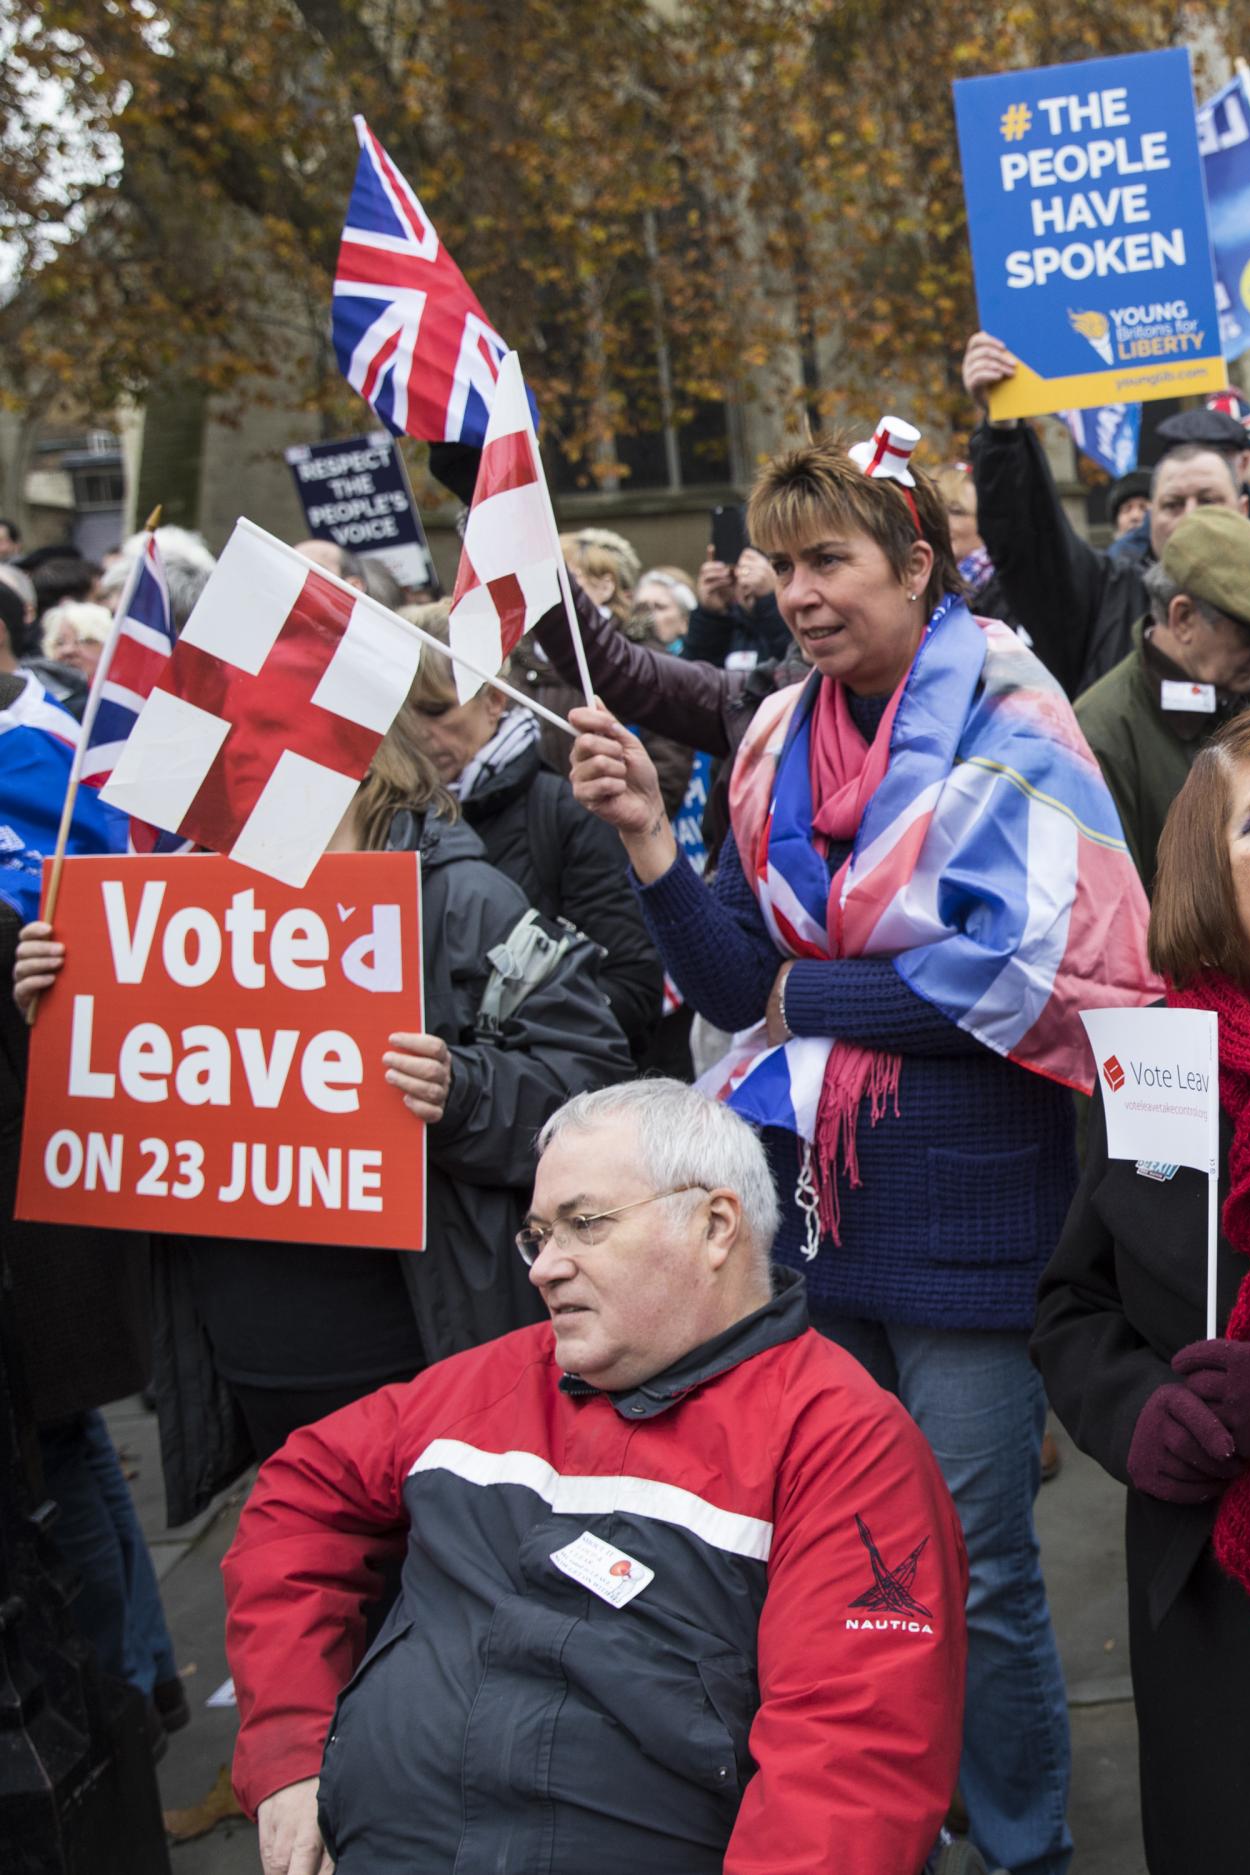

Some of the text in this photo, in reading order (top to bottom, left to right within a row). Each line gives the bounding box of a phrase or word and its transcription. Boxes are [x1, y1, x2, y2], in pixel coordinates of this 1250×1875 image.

[1037, 87, 1131, 135] THE
[1000, 131, 1170, 192] PEOPLE
[1031, 183, 1151, 236] HAVE
[1005, 228, 1186, 289] SPOKEN
[1109, 300, 1188, 326] YOUNG
[1116, 320, 1197, 342] Britons for
[1118, 332, 1204, 360] LIBERTY
[297, 449, 390, 482] RESPECT
[327, 472, 376, 499] THE
[308, 490, 409, 528] PEOPLE'S
[330, 515, 399, 545] VOICE
[69, 994, 364, 1114] Leave
[1130, 1061, 1172, 1088] Vote
[45, 1129, 383, 1212] ON 23 JUNE
[845, 1619, 934, 1634] NAUTICA
